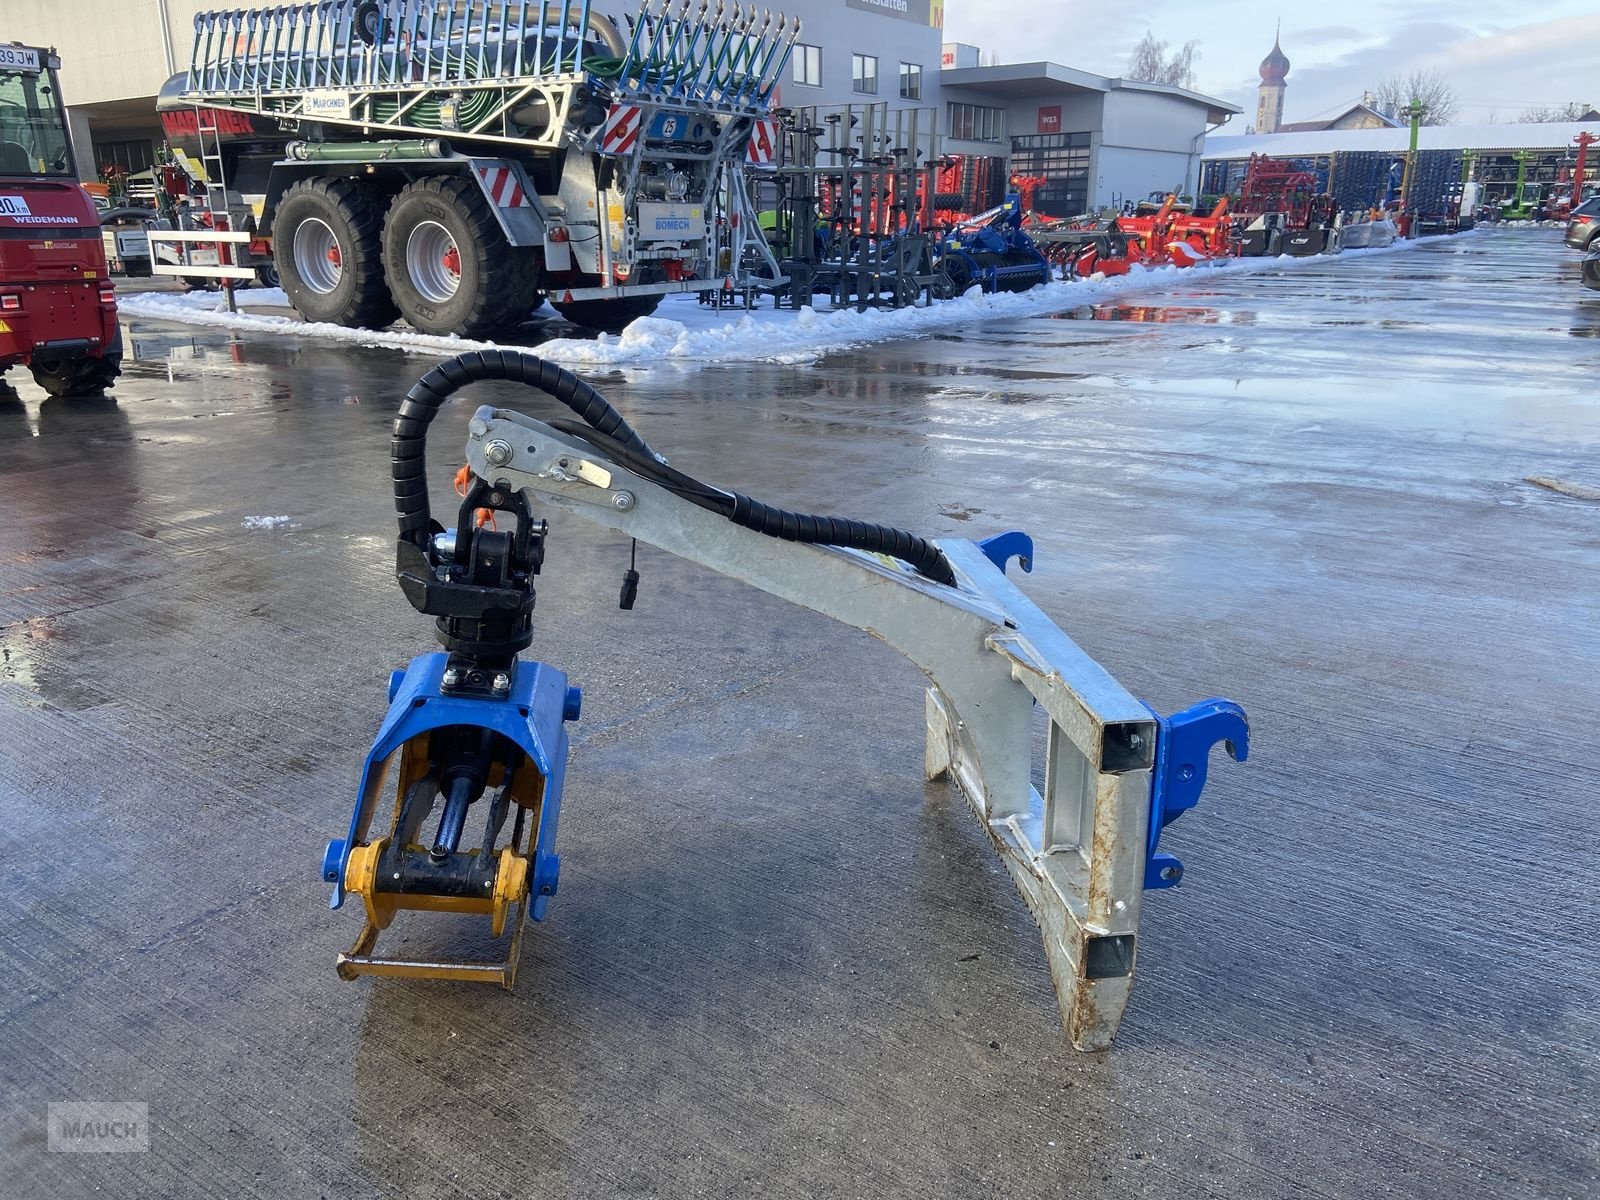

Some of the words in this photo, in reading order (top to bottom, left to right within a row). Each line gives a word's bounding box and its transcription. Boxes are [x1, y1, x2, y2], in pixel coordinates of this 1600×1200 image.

[17, 51, 34, 65] JW
[312, 97, 345, 108] MARCHNER
[664, 119, 675, 134] 25
[12, 216, 79, 224] WEIDEMANN
[655, 220, 690, 230] BOMECH
